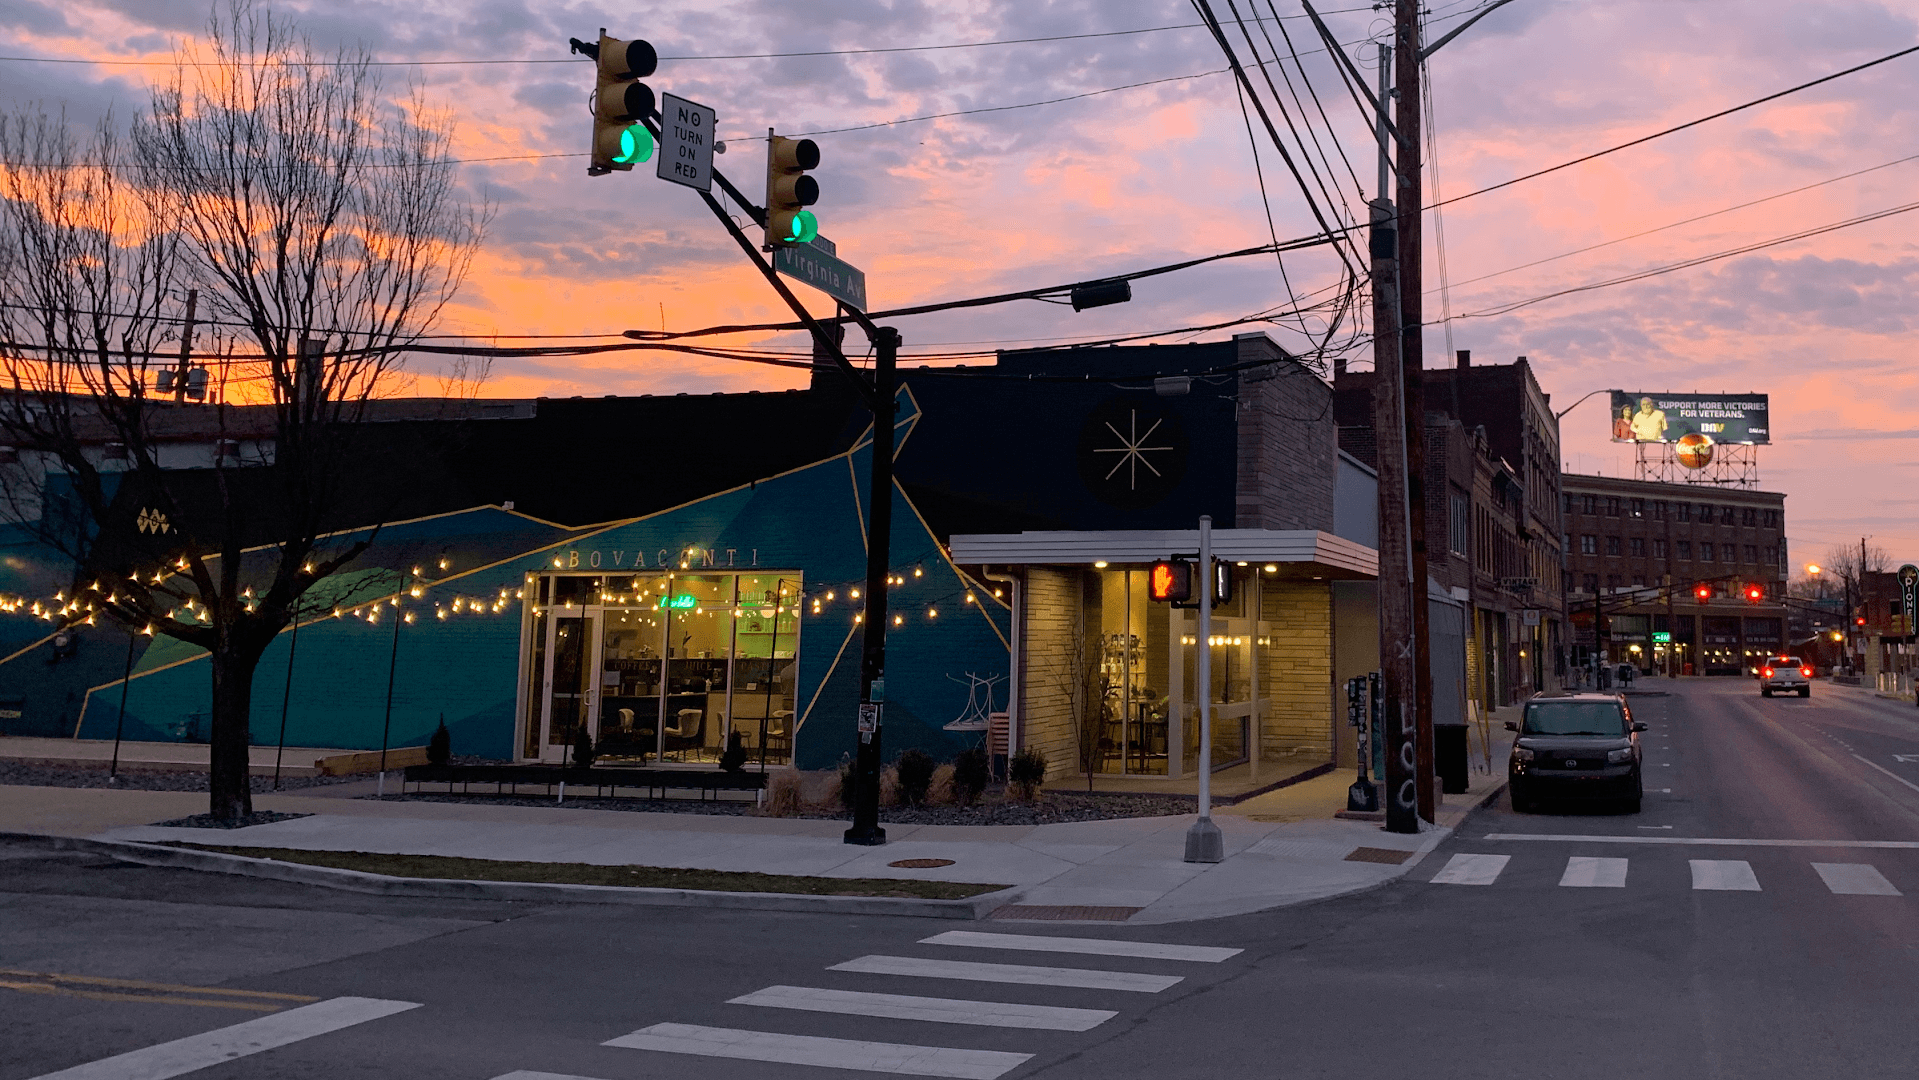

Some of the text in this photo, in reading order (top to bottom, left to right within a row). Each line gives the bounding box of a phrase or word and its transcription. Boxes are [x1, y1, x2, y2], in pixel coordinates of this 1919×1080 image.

[678, 107, 701, 127] NO
[674, 126, 702, 146] TURN
[679, 145, 696, 160] ON
[674, 162, 697, 178] RED
[784, 247, 840, 288] Virginia
[1658, 401, 1766, 411] SUPPORT MORE VICTORIES
[1680, 410, 1745, 419] FOR VETERANS.
[568, 549, 758, 569] BOVACONTI
[1904, 577, 1916, 636] PIONE
[684, 660, 712, 671] JUICE
